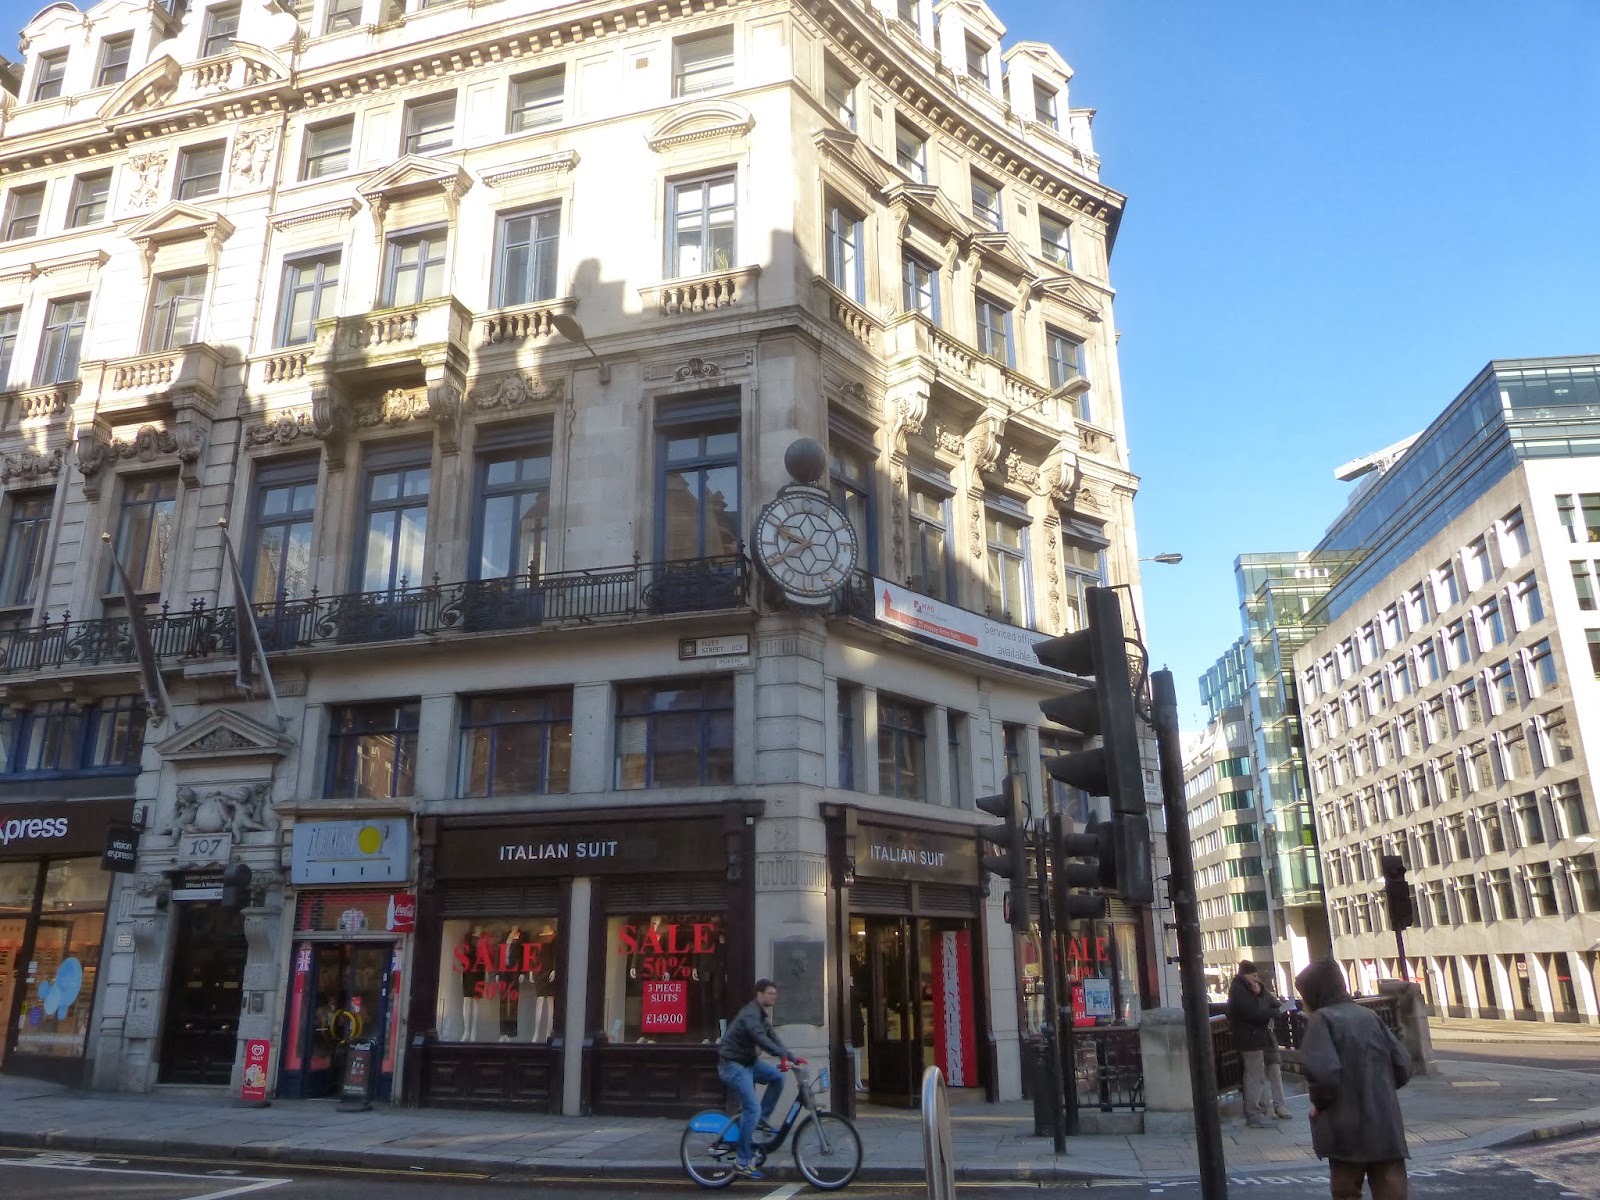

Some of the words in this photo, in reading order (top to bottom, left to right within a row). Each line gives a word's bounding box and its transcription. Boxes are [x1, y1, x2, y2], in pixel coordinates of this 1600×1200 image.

[940, 627, 951, 637] from
[985, 623, 1016, 642] Serviced
[1017, 635, 1040, 646] office
[998, 646, 1031, 662] available
[113, 840, 132, 850] vision
[189, 839, 222, 856] 107
[500, 843, 569, 860] ITALIAN
[575, 841, 618, 857] SUIT
[107, 850, 134, 860] express
[870, 845, 916, 864] ITALIAN
[920, 850, 944, 866] SUIT
[618, 923, 716, 955] SALE
[452, 943, 543, 973] SALE
[1054, 936, 1109, 962] ALE
[642, 957, 692, 978] 50%
[474, 981, 519, 1001] 50%
[648, 984, 653, 992] 3
[655, 984, 682, 993] PIECE
[651, 994, 678, 1002] SUITS
[645, 1013, 683, 1025] £149.00
[950, 1046, 960, 1086] SAL
[1226, 1175, 1332, 1186] RIGH
